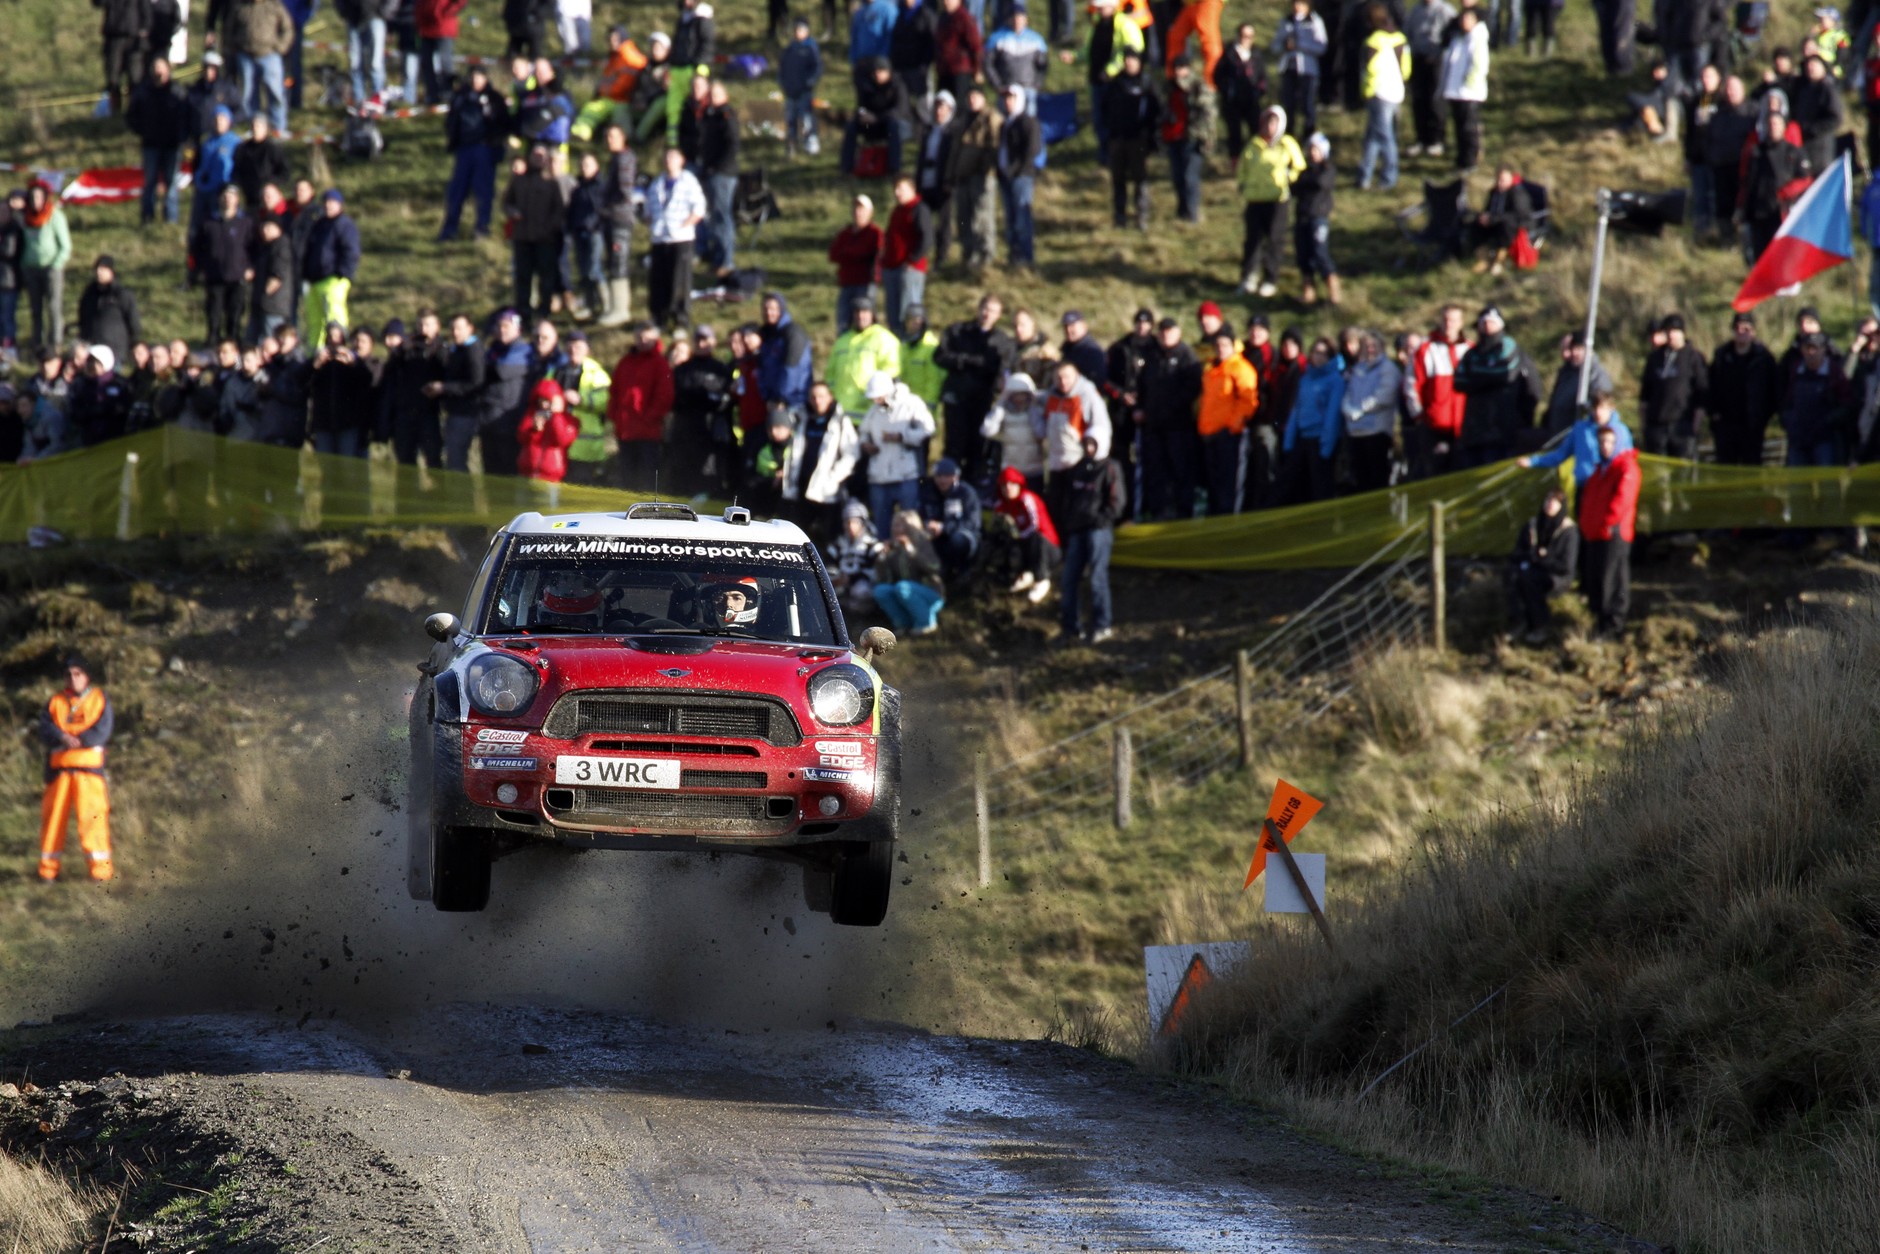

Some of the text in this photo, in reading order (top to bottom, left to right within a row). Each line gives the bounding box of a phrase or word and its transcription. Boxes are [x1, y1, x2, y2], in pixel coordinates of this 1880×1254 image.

[519, 541, 805, 564] www.MINImotorsport.com
[488, 731, 524, 742] Castrol
[471, 742, 526, 755] EDGE
[827, 743, 858, 753] Castrol
[486, 760, 534, 768] MICHELIN
[819, 755, 866, 769] EDGE
[576, 760, 658, 784] 3 WRC
[1275, 796, 1301, 830] RALLY GB
